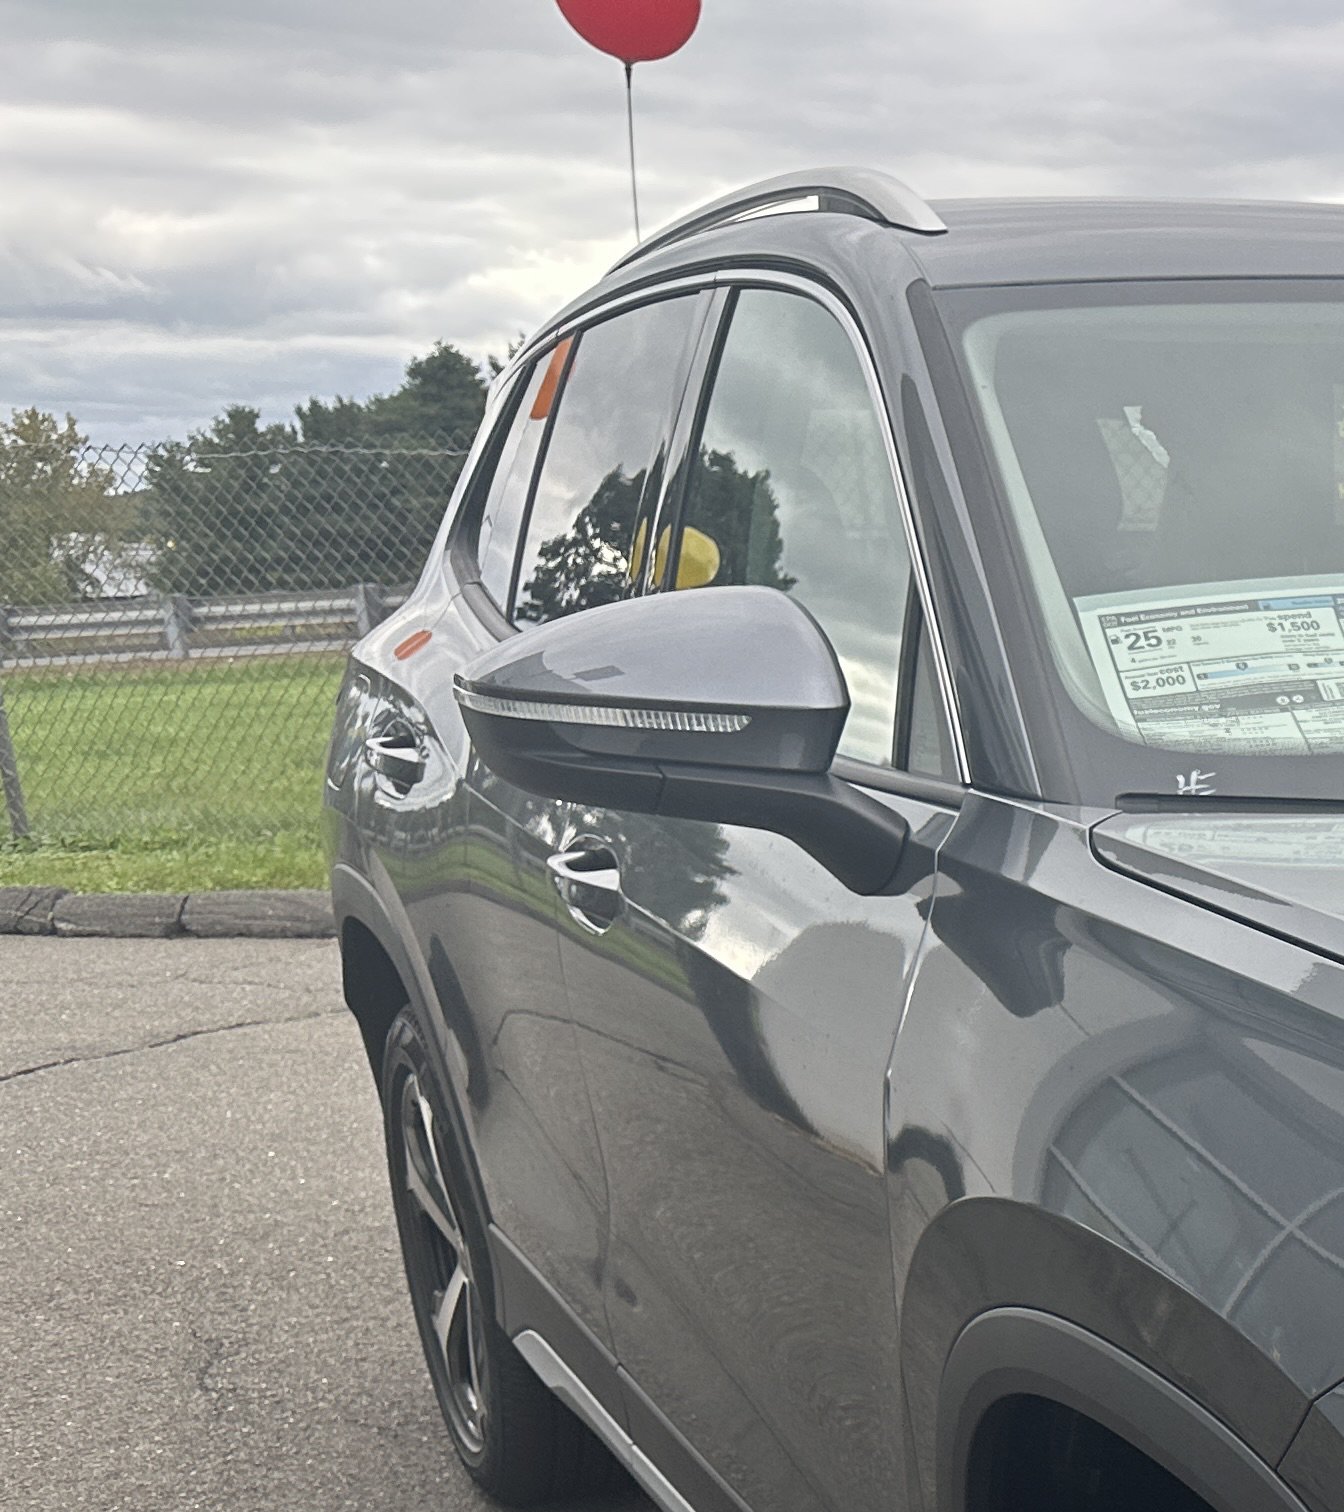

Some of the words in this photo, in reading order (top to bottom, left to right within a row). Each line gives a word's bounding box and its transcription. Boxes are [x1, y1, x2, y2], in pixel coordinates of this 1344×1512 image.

[1266, 620, 1321, 633] $1,500
[1124, 629, 1164, 651] 25
[1130, 674, 1187, 691] $2,000
